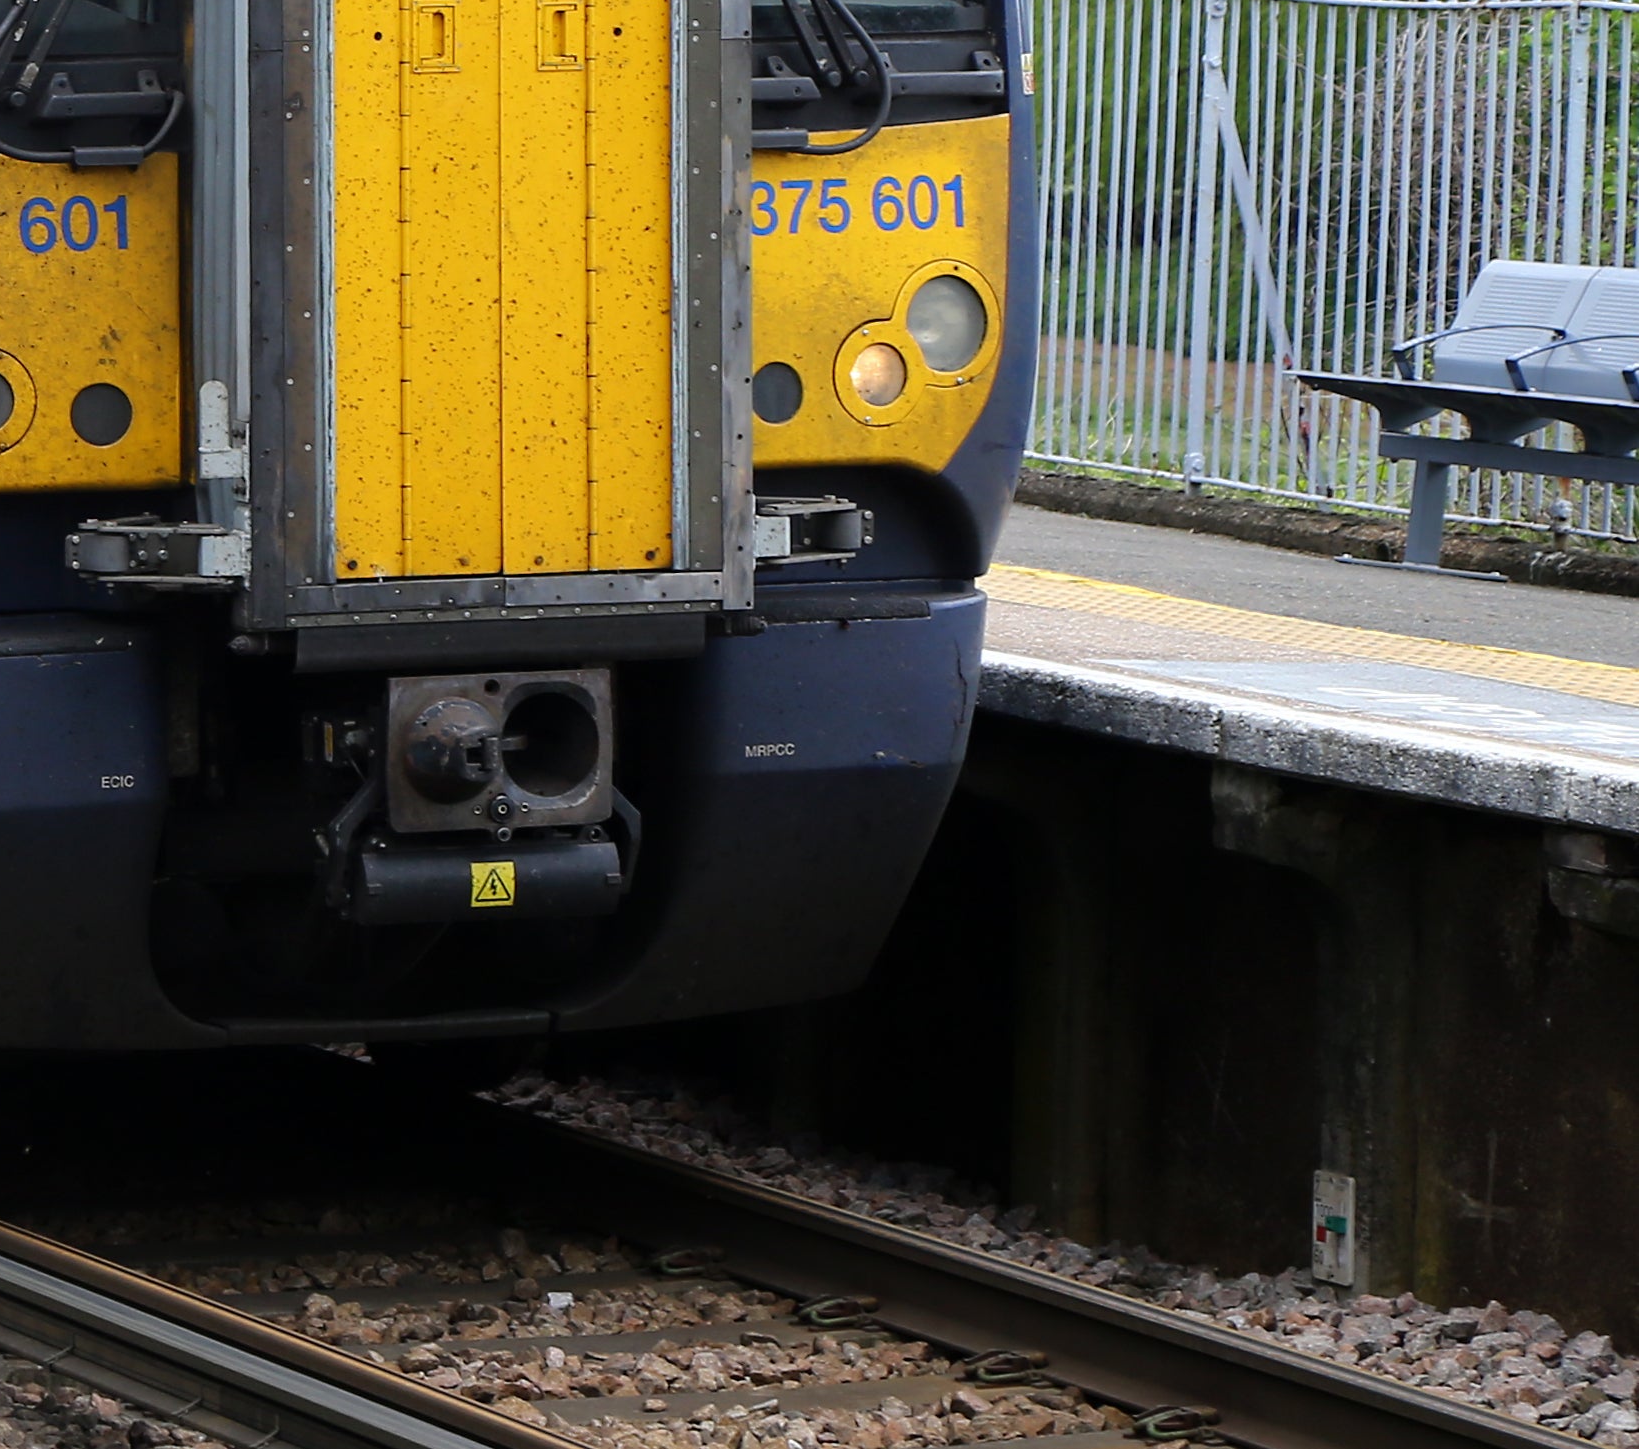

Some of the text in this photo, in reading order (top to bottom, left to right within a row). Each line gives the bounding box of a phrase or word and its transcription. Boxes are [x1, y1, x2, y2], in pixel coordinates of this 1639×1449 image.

[751, 174, 965, 236] 375 601
[19, 194, 129, 254] 601
[745, 743, 796, 758] MRPCC
[101, 775, 135, 789] ECIC
